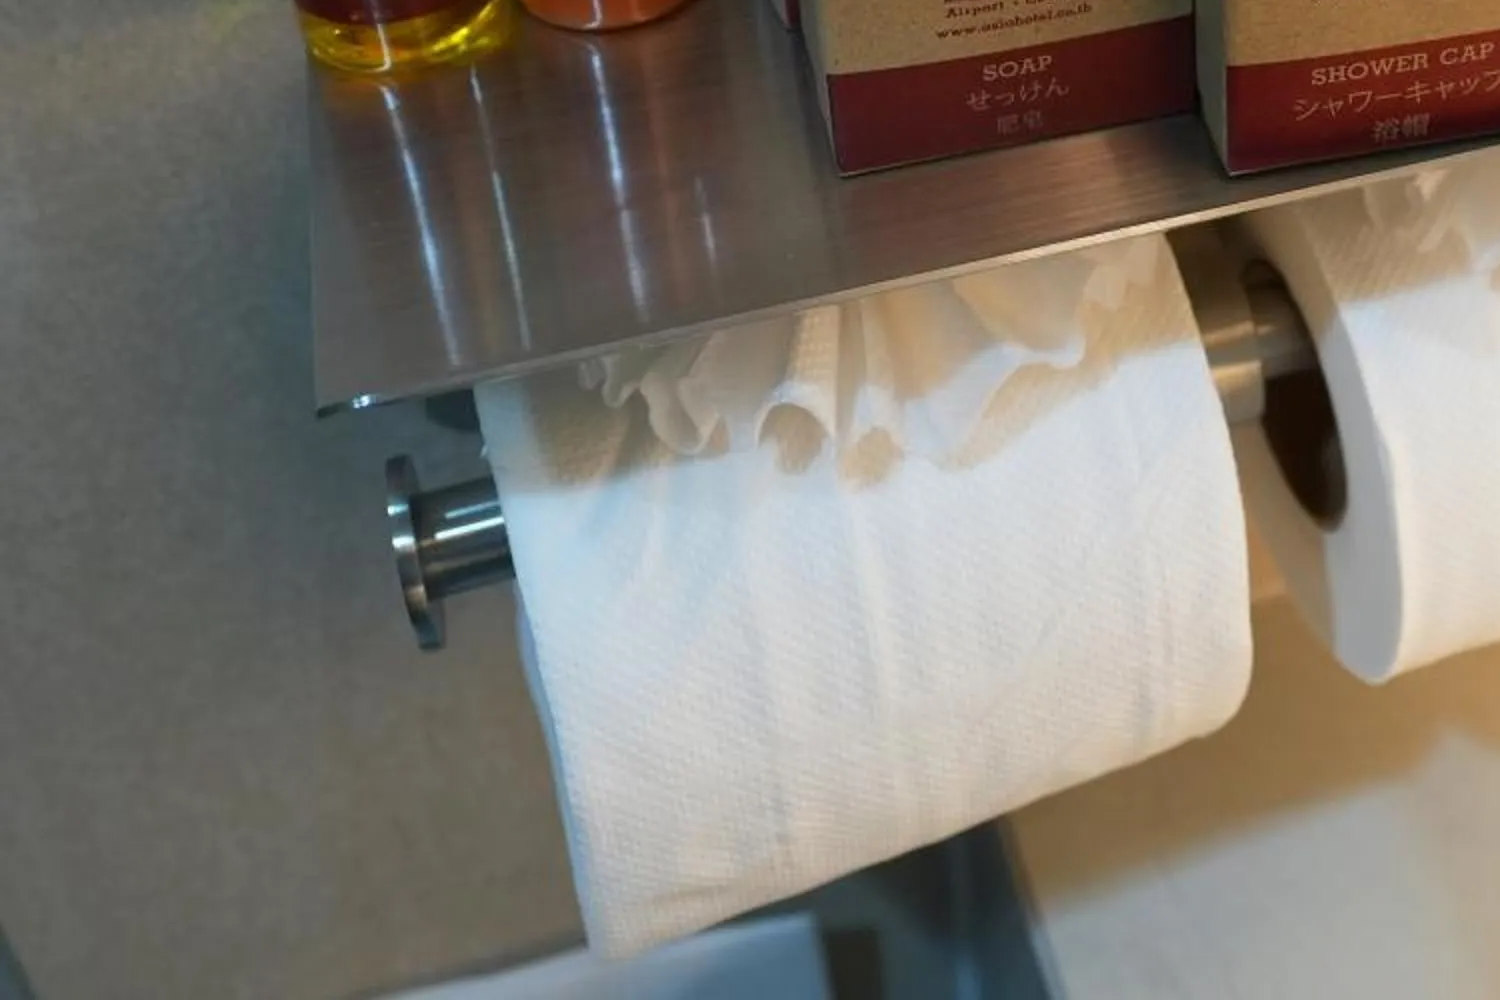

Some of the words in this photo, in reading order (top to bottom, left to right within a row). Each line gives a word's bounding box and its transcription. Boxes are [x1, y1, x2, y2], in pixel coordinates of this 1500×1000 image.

[945, 1, 1005, 19] Airport
[982, 55, 1053, 82] SOAP
[1311, 52, 1429, 87] SHOWER
[1440, 41, 1495, 66] CAP
[966, 76, 1070, 110] せっけん
